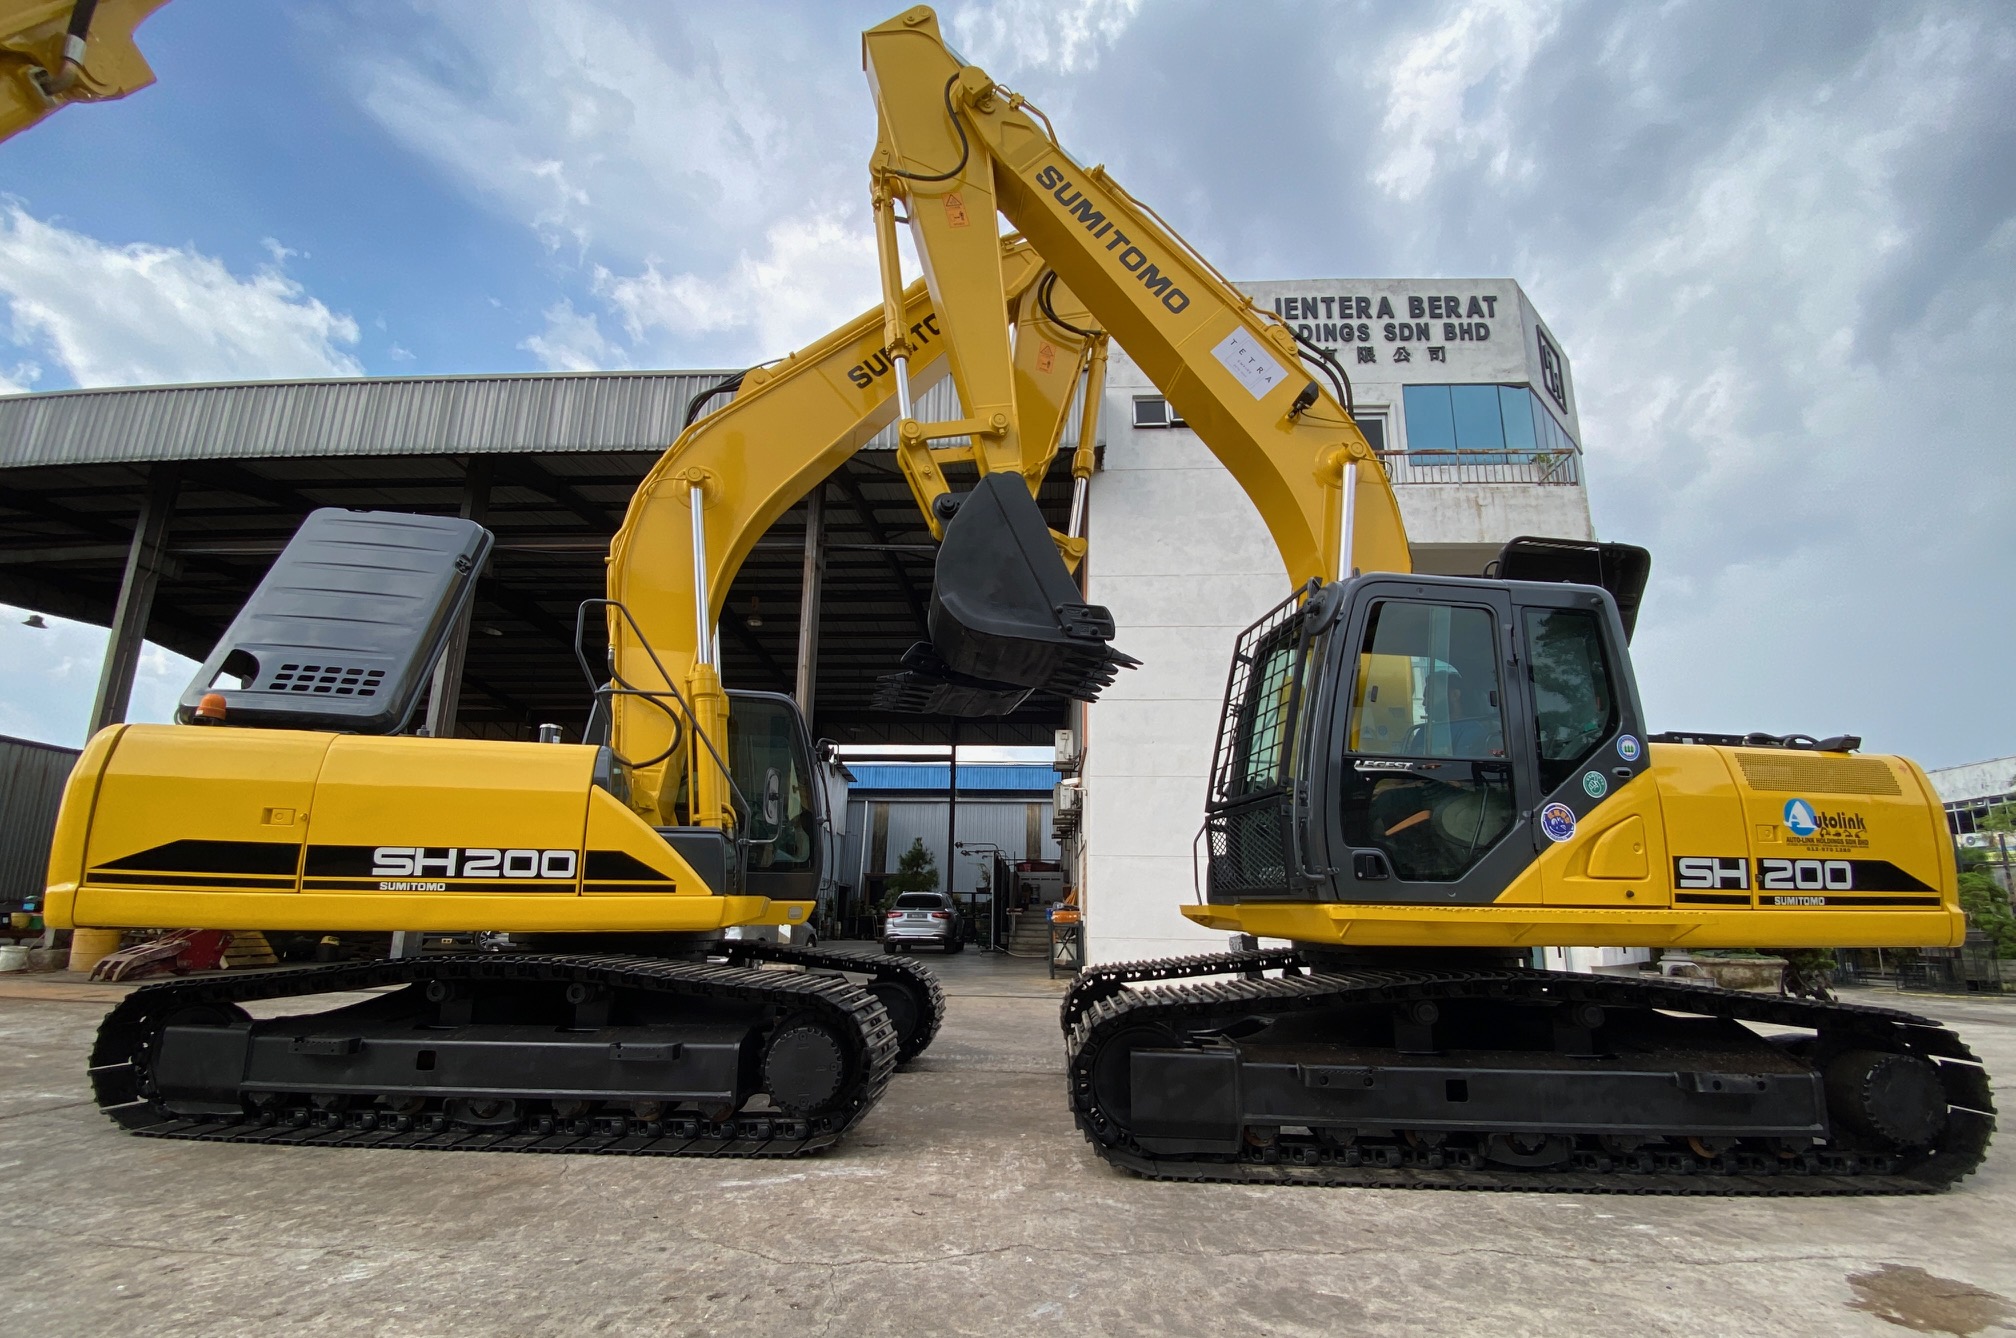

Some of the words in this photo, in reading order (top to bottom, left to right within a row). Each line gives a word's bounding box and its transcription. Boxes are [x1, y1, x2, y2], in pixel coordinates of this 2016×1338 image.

[1035, 165, 1191, 315] SUMITOMO
[1408, 296, 1498, 319] BERAT
[1297, 323, 1371, 342] DINGS
[1384, 322, 1431, 341] SDN
[1443, 322, 1491, 341] BHD
[847, 312, 941, 389] SUTO
[1230, 338, 1272, 384] TETRA
[1354, 760, 1413, 771] LEGEST
[1784, 801, 1867, 830] Autolink
[379, 881, 446, 892] SUMITOMO
[1774, 896, 1825, 906] SUMITOMO
